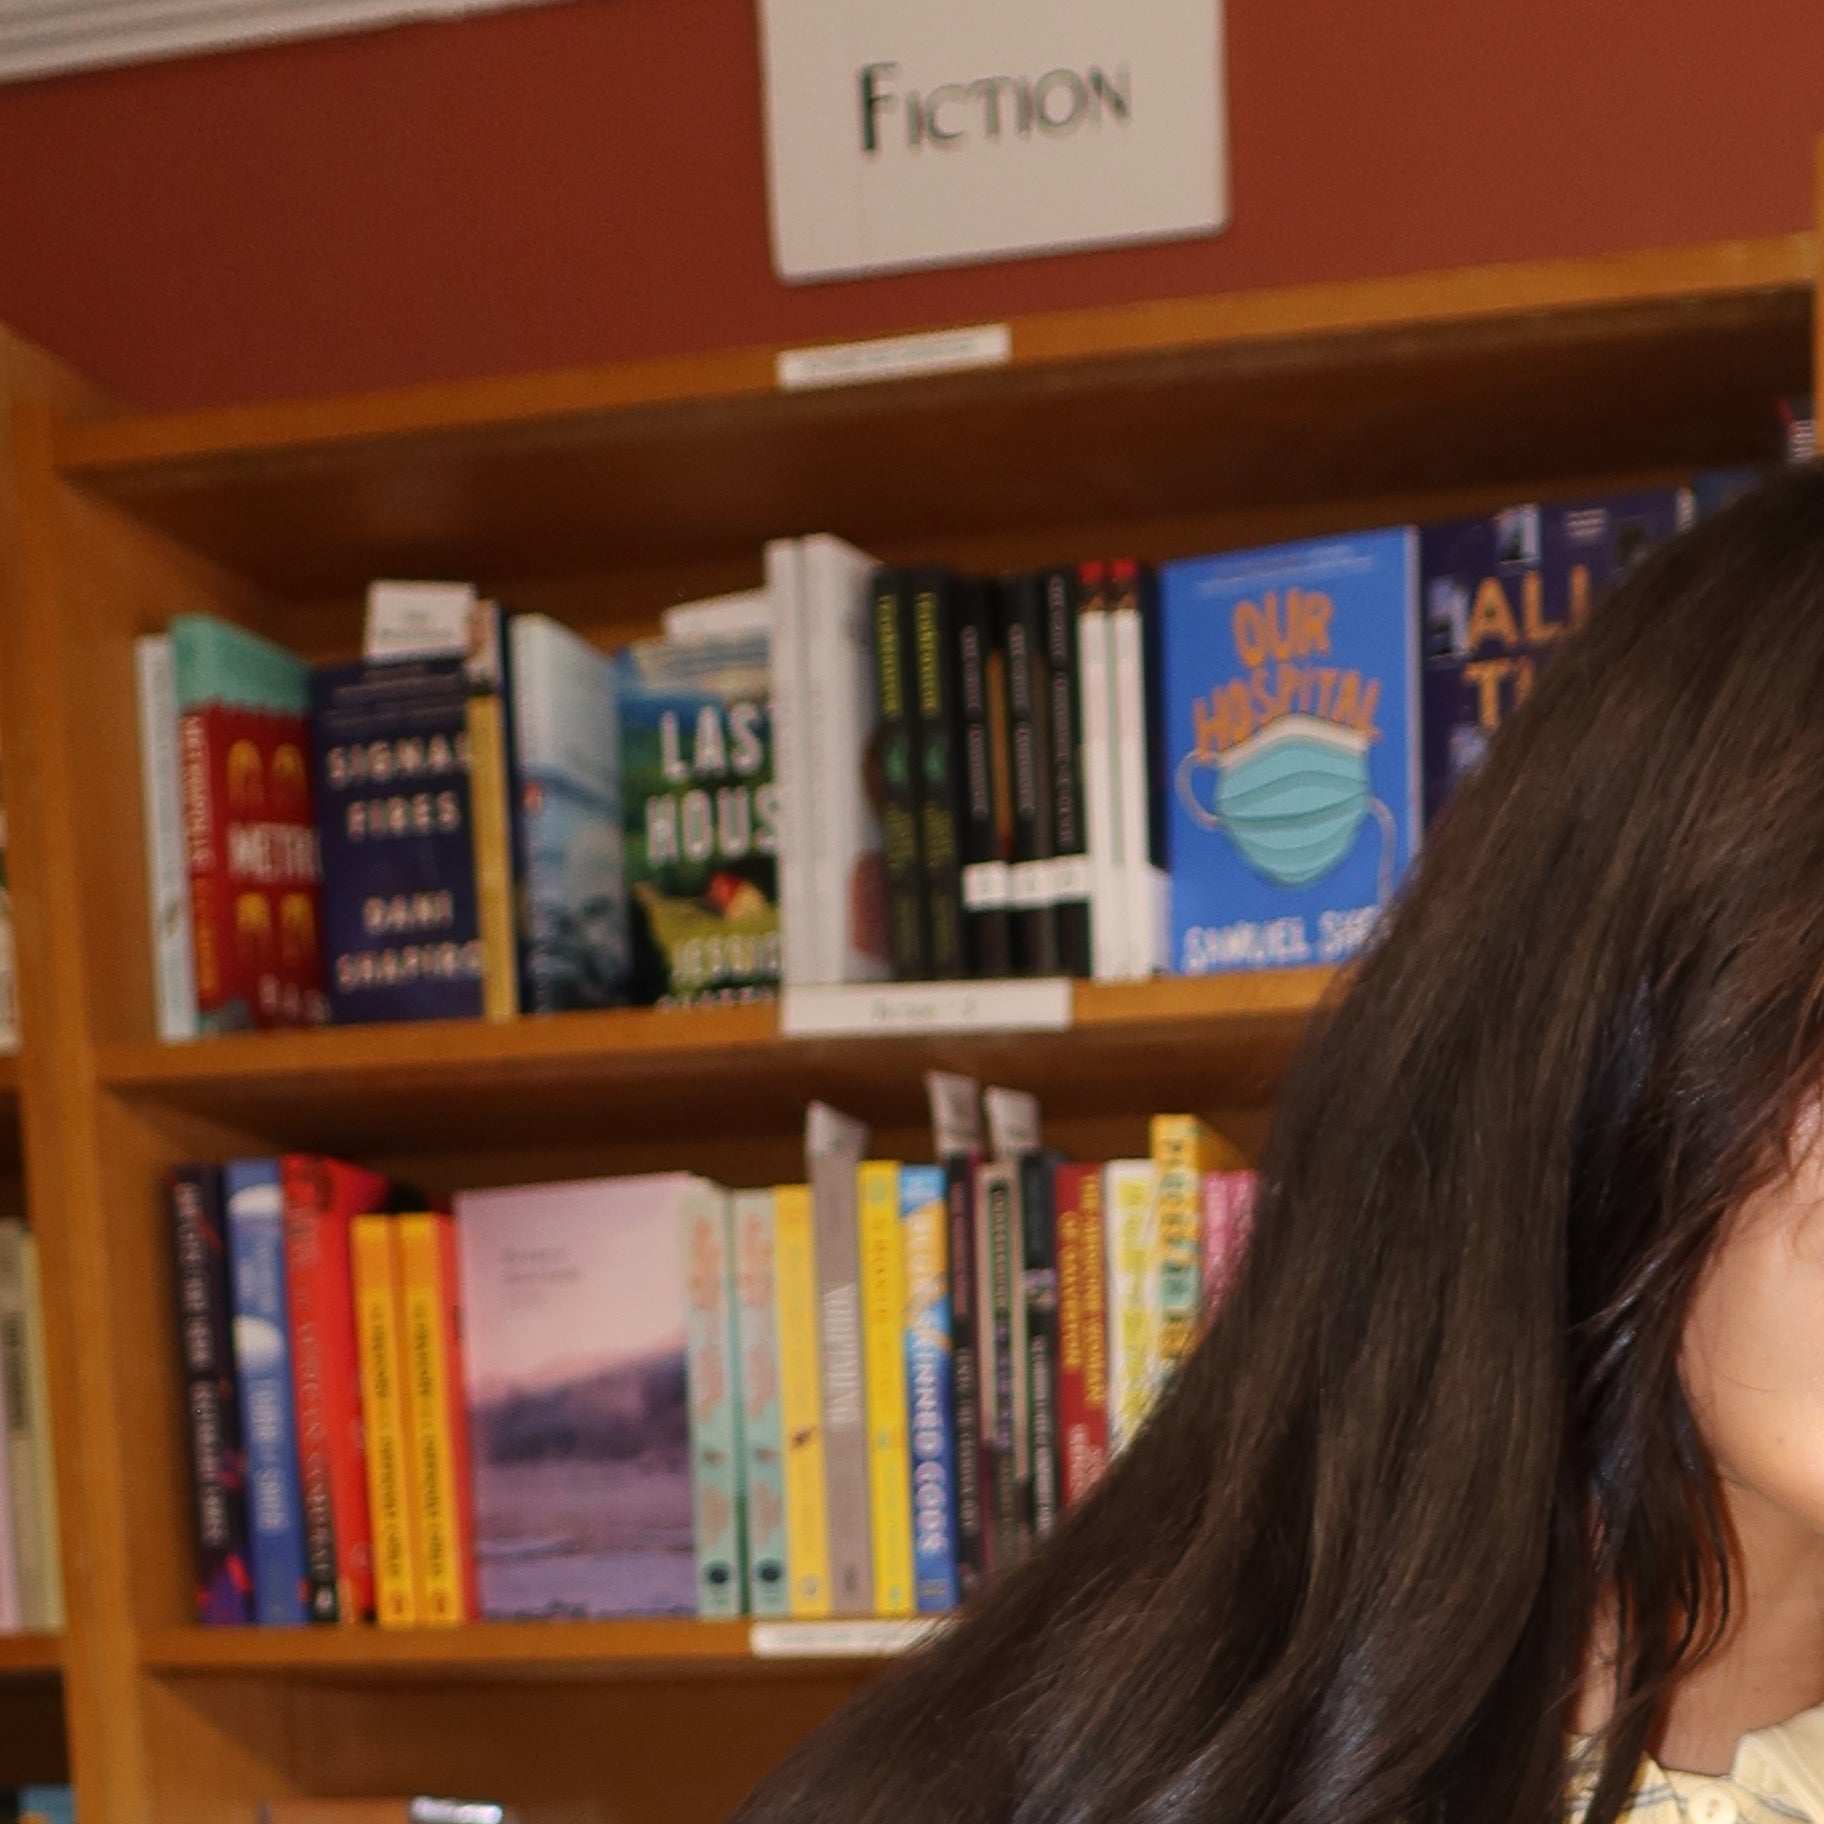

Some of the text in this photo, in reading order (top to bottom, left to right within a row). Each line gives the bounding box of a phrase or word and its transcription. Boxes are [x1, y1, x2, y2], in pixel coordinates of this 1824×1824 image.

[858, 61, 1132, 155] FICTION
[1233, 587, 1334, 668] OUR
[660, 704, 765, 781] LAS
[1192, 660, 1383, 766] HOSPITAL
[646, 784, 780, 862] HOUS
